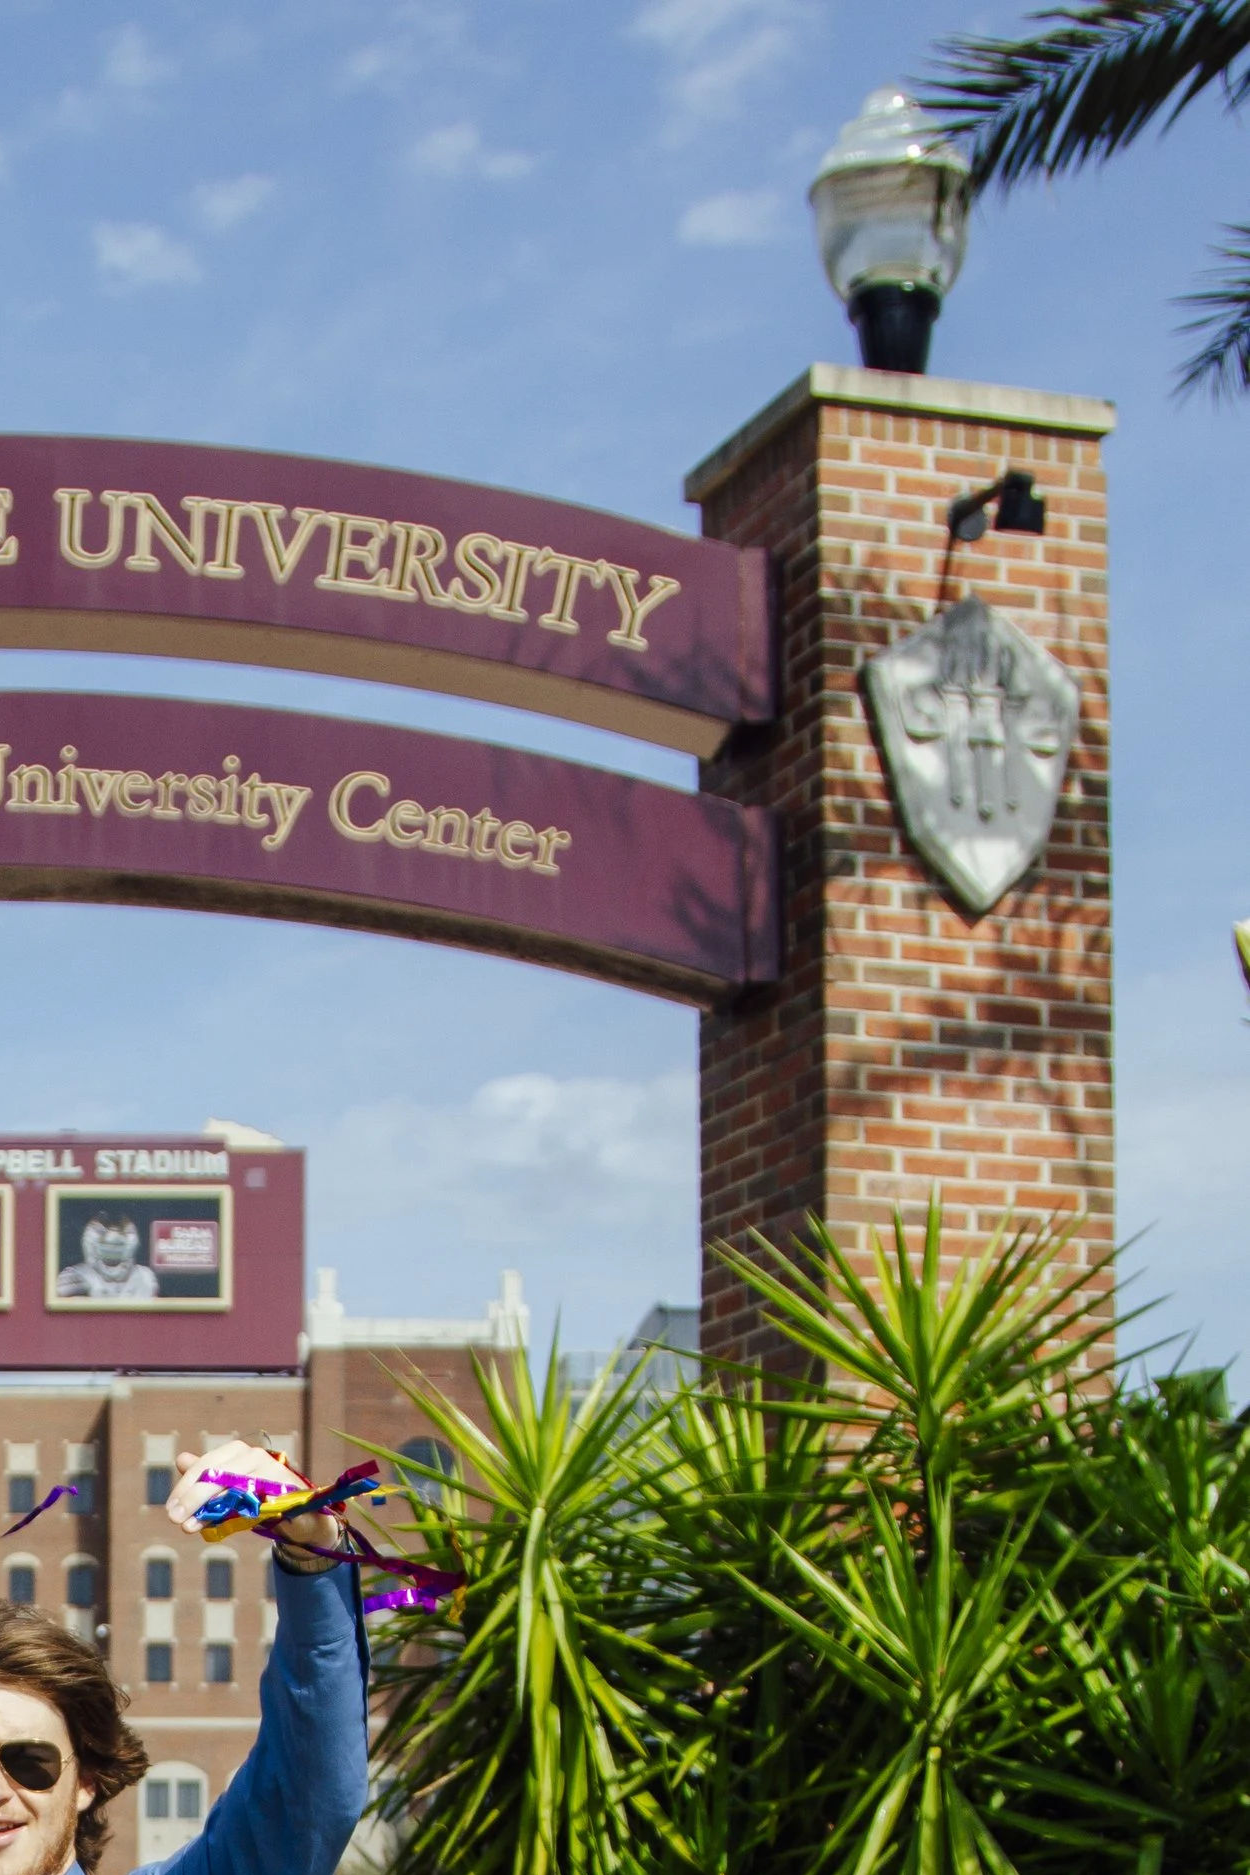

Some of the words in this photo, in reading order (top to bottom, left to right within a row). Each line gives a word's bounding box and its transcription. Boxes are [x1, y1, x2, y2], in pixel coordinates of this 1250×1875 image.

[53, 487, 681, 652] UNIVERSITY
[327, 770, 573, 877] Center
[95, 1149, 229, 1178] STADIUM
